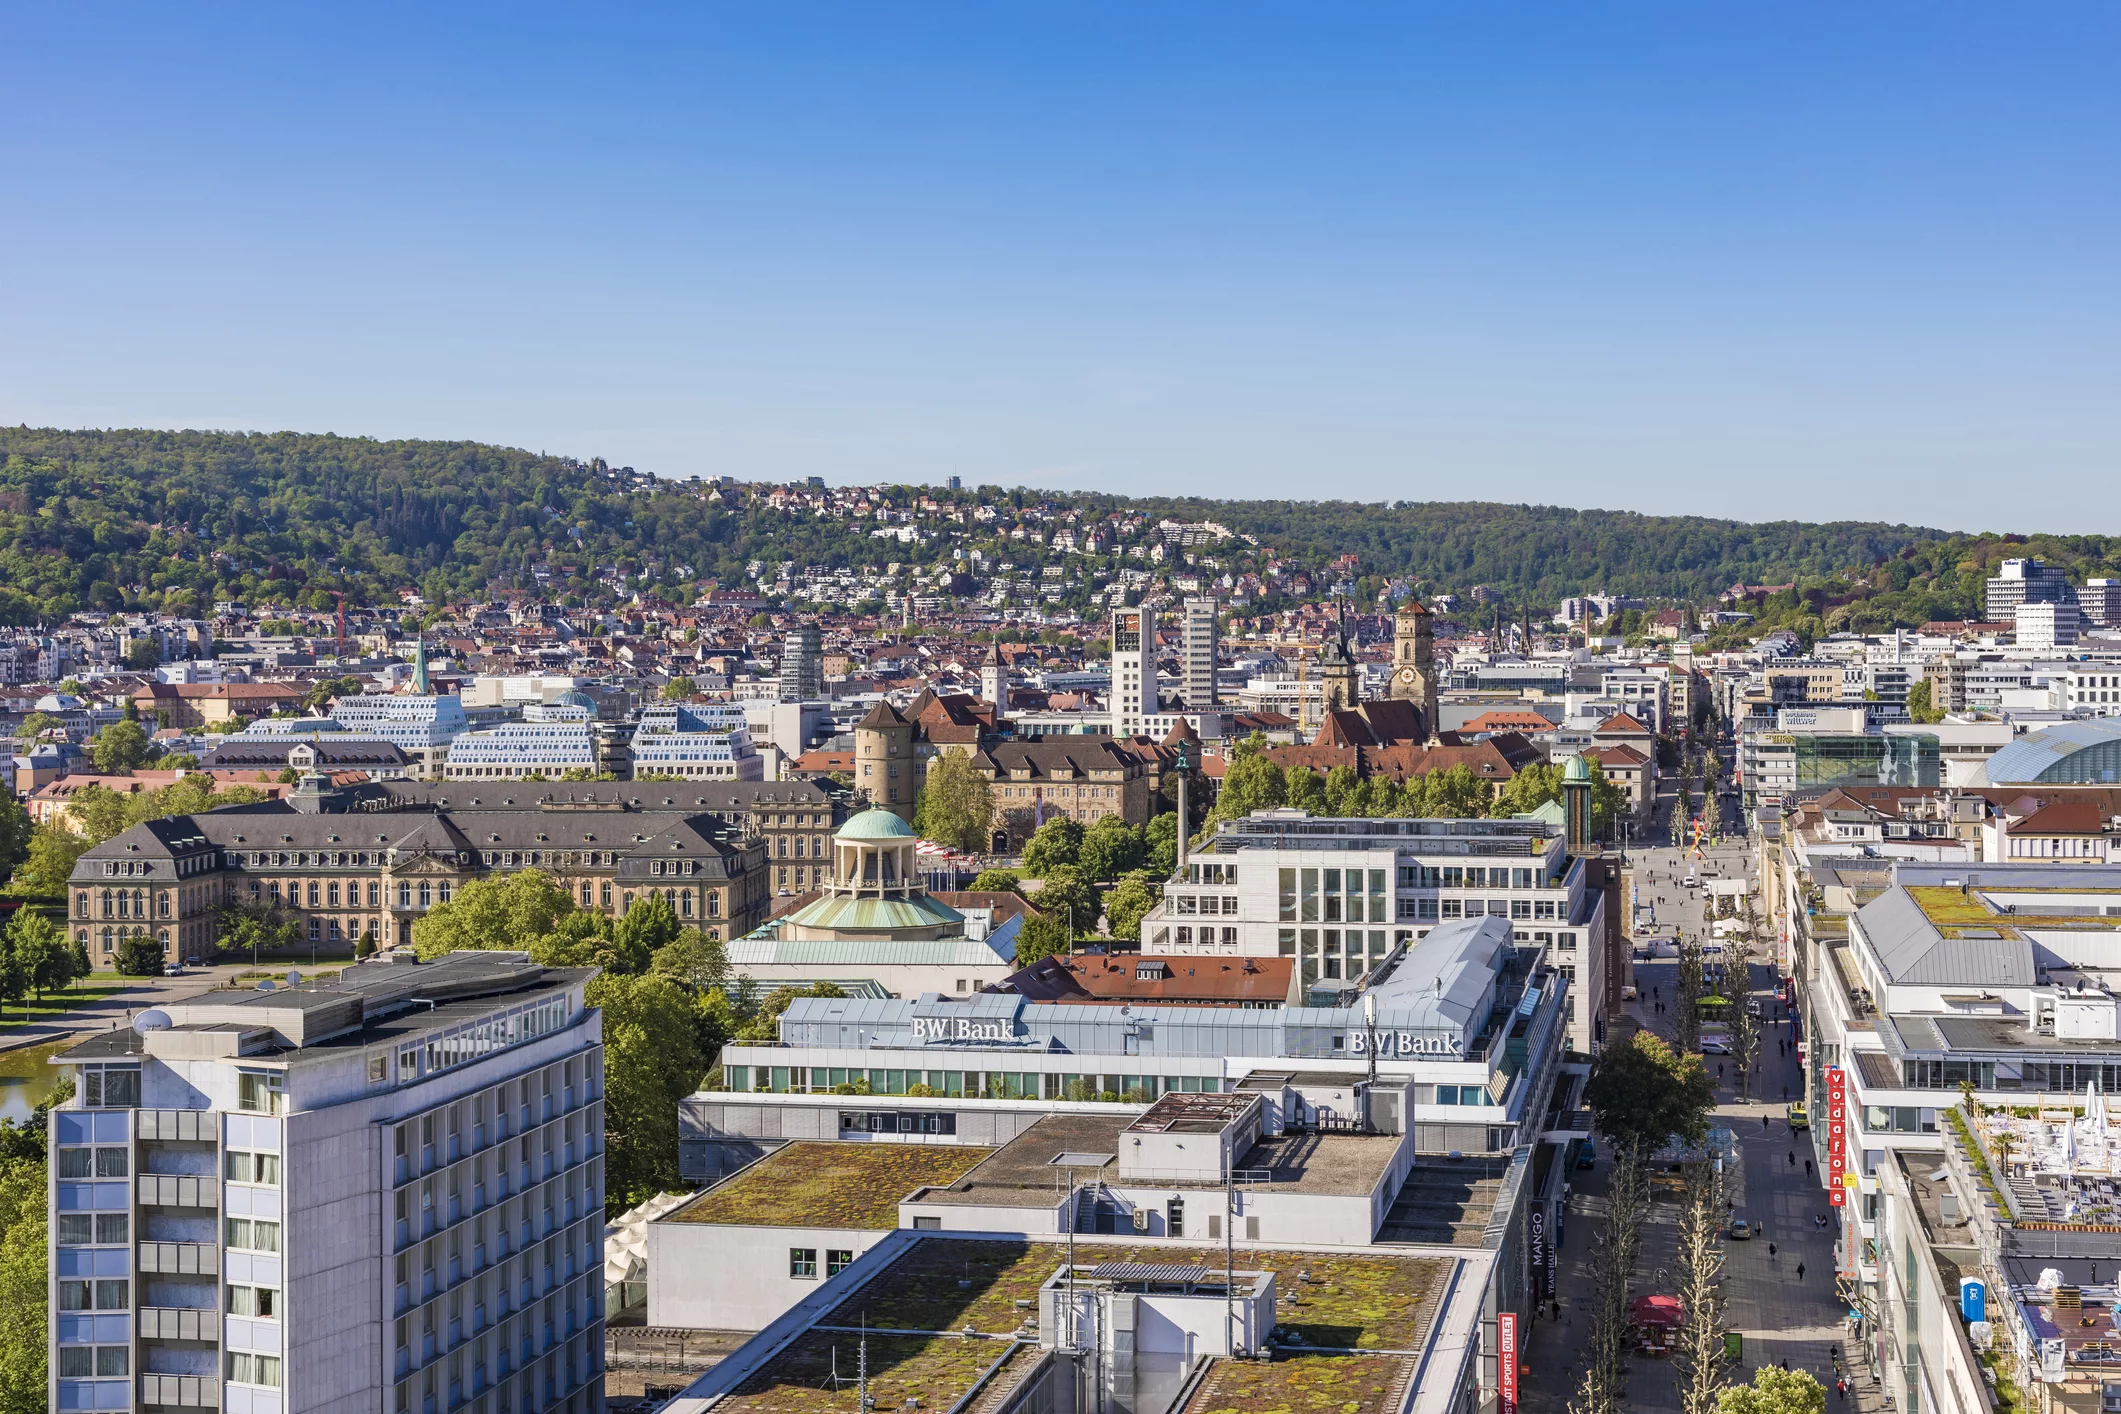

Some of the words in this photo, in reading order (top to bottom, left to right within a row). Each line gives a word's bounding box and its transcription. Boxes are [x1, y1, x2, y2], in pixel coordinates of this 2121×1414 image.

[912, 1018, 948, 1038] BW
[956, 1018, 1014, 1040] Bank
[1398, 1032, 1459, 1054] Bank
[1832, 1074, 1842, 1202] vodafone
[1533, 1213, 1542, 1265] MANGO
[1504, 1353, 1512, 1386] SPORTS
